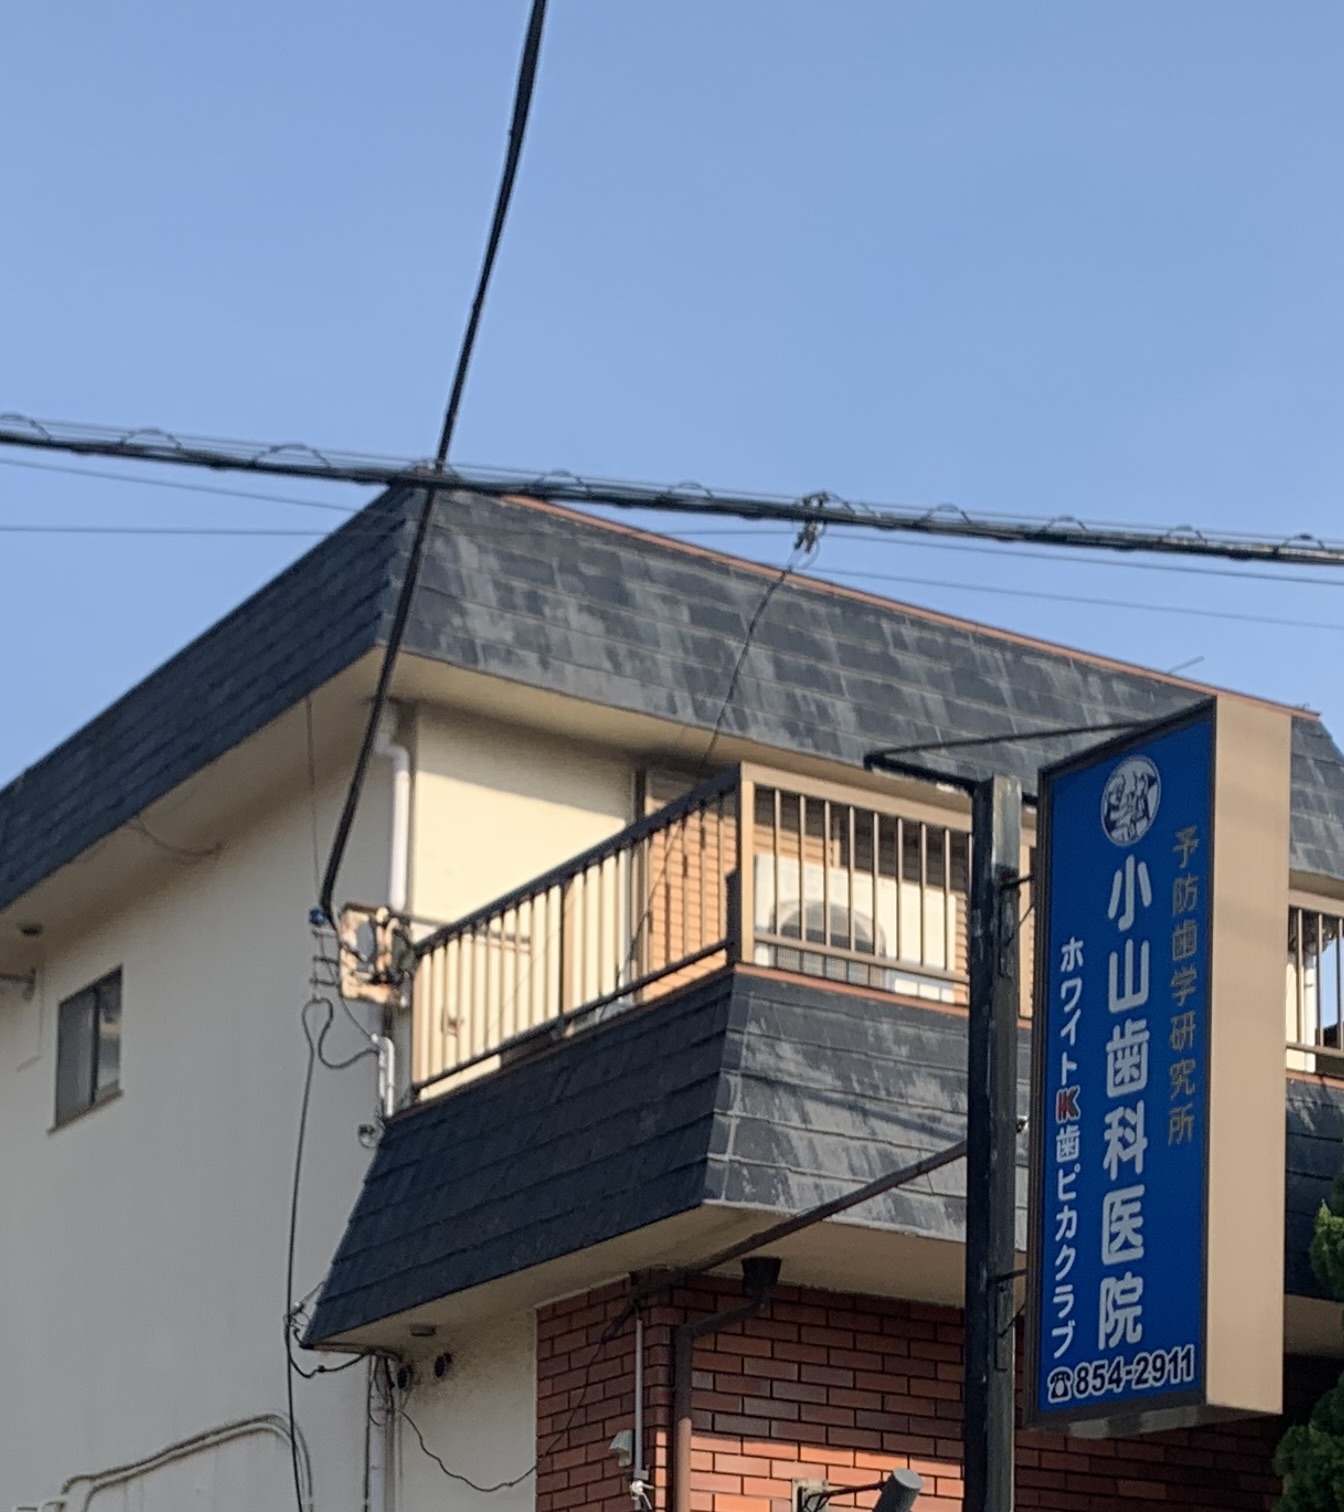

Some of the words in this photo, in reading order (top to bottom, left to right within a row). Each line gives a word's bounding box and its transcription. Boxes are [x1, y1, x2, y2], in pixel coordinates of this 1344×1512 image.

[1052, 936, 1084, 1359] ホワイトK歯ピカクラブ
[1098, 854, 1152, 1350] 小山歯科医院
[1168, 824, 1199, 1146] 予防歯学研究所
[1074, 1344, 1195, 1397] 854-2911
